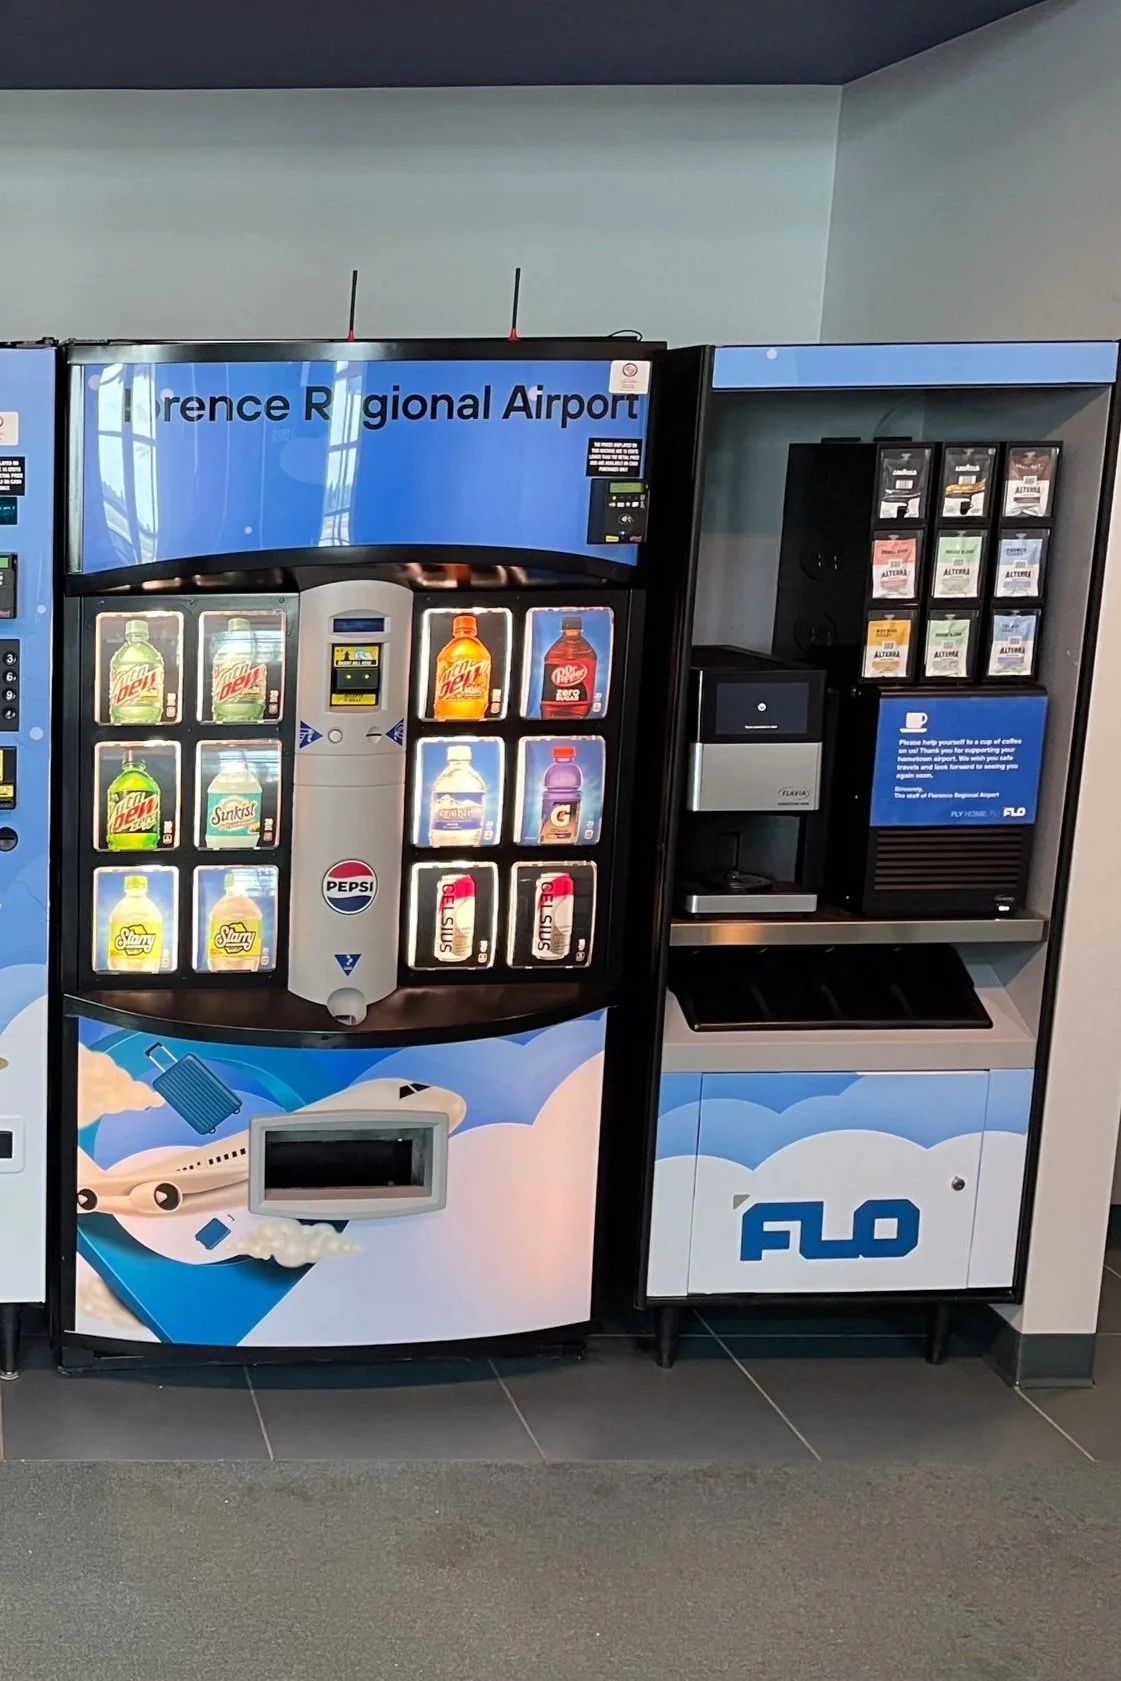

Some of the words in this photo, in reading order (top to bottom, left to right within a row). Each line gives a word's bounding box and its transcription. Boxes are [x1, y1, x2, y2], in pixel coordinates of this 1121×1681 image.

[305, 385, 489, 430] Rgional
[501, 385, 638, 429] Airport
[1015, 486, 1041, 494] ALTERRA
[881, 568, 908, 578] ALTERRA
[943, 568, 970, 576] ALTERRA
[1005, 570, 1032, 578] ALTERRA
[873, 650, 901, 659] ALTERRA
[934, 650, 959, 659] ALTERRA
[999, 646, 1026, 655] ALTERRA
[6, 654, 13, 663] 3
[6, 672, 13, 682] 6
[556, 668, 586, 684] Pepper
[6, 690, 13, 700] 9
[556, 689, 581, 697] zero
[922, 739, 938, 747] help
[938, 738, 966, 747] yourself
[986, 755, 999, 763] you
[934, 763, 949, 771] look
[984, 763, 1006, 771] seeing
[979, 791, 1000, 799] Airport
[211, 802, 257, 825] Sunkist
[550, 804, 571, 828] G
[950, 810, 963, 818] FLY
[1002, 806, 1027, 817] FLO
[326, 881, 374, 893] PEPSI
[440, 883, 455, 953] CELSIUS
[538, 881, 553, 951] CELSIUS
[115, 925, 156, 952] Starry
[215, 923, 256, 950] Starry
[740, 1198, 921, 1262] FLO
